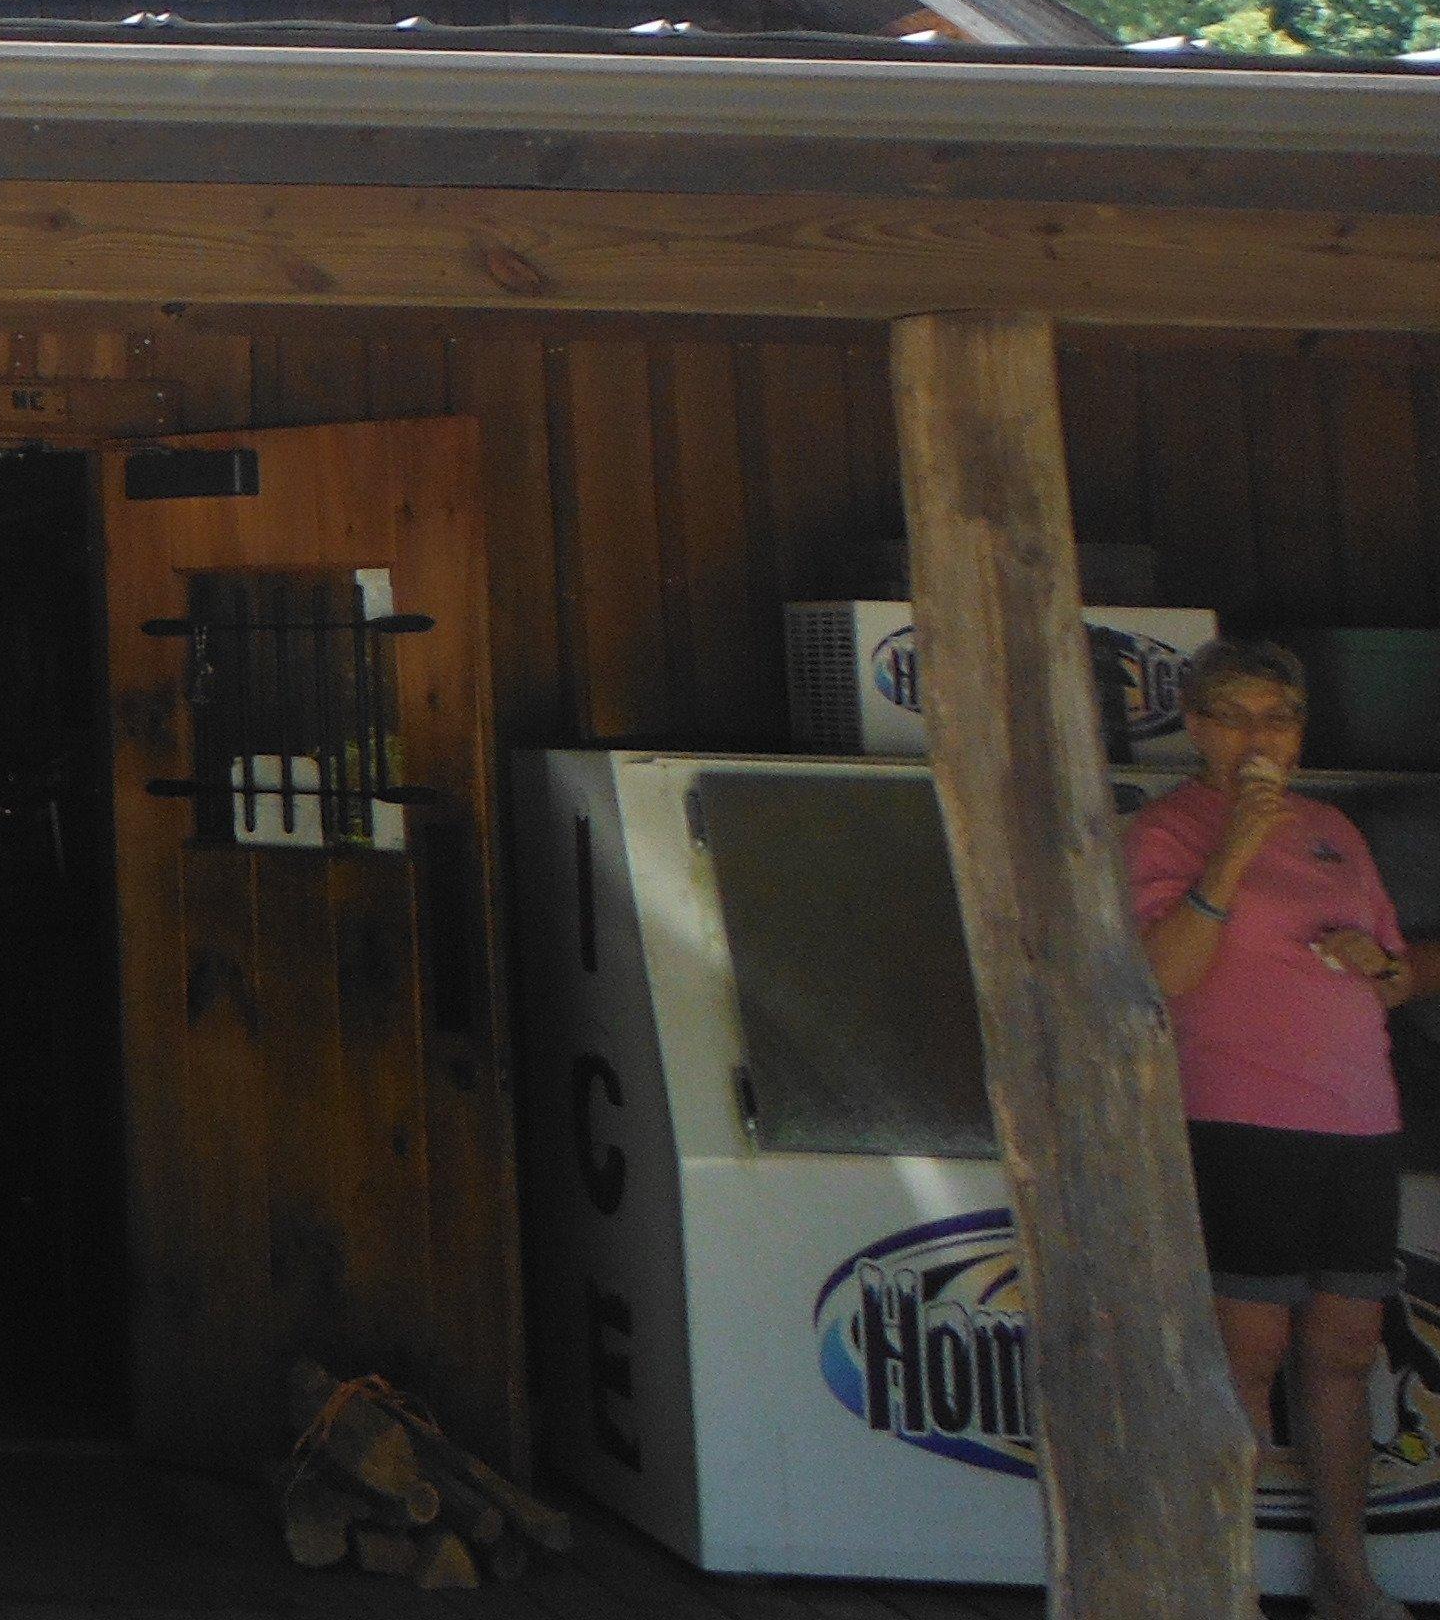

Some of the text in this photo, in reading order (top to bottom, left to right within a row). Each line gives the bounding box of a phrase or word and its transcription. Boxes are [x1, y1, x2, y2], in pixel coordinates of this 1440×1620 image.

[11, 389, 47, 412] NC
[572, 813, 644, 1476] ICE
[856, 1257, 1036, 1440] Hom
